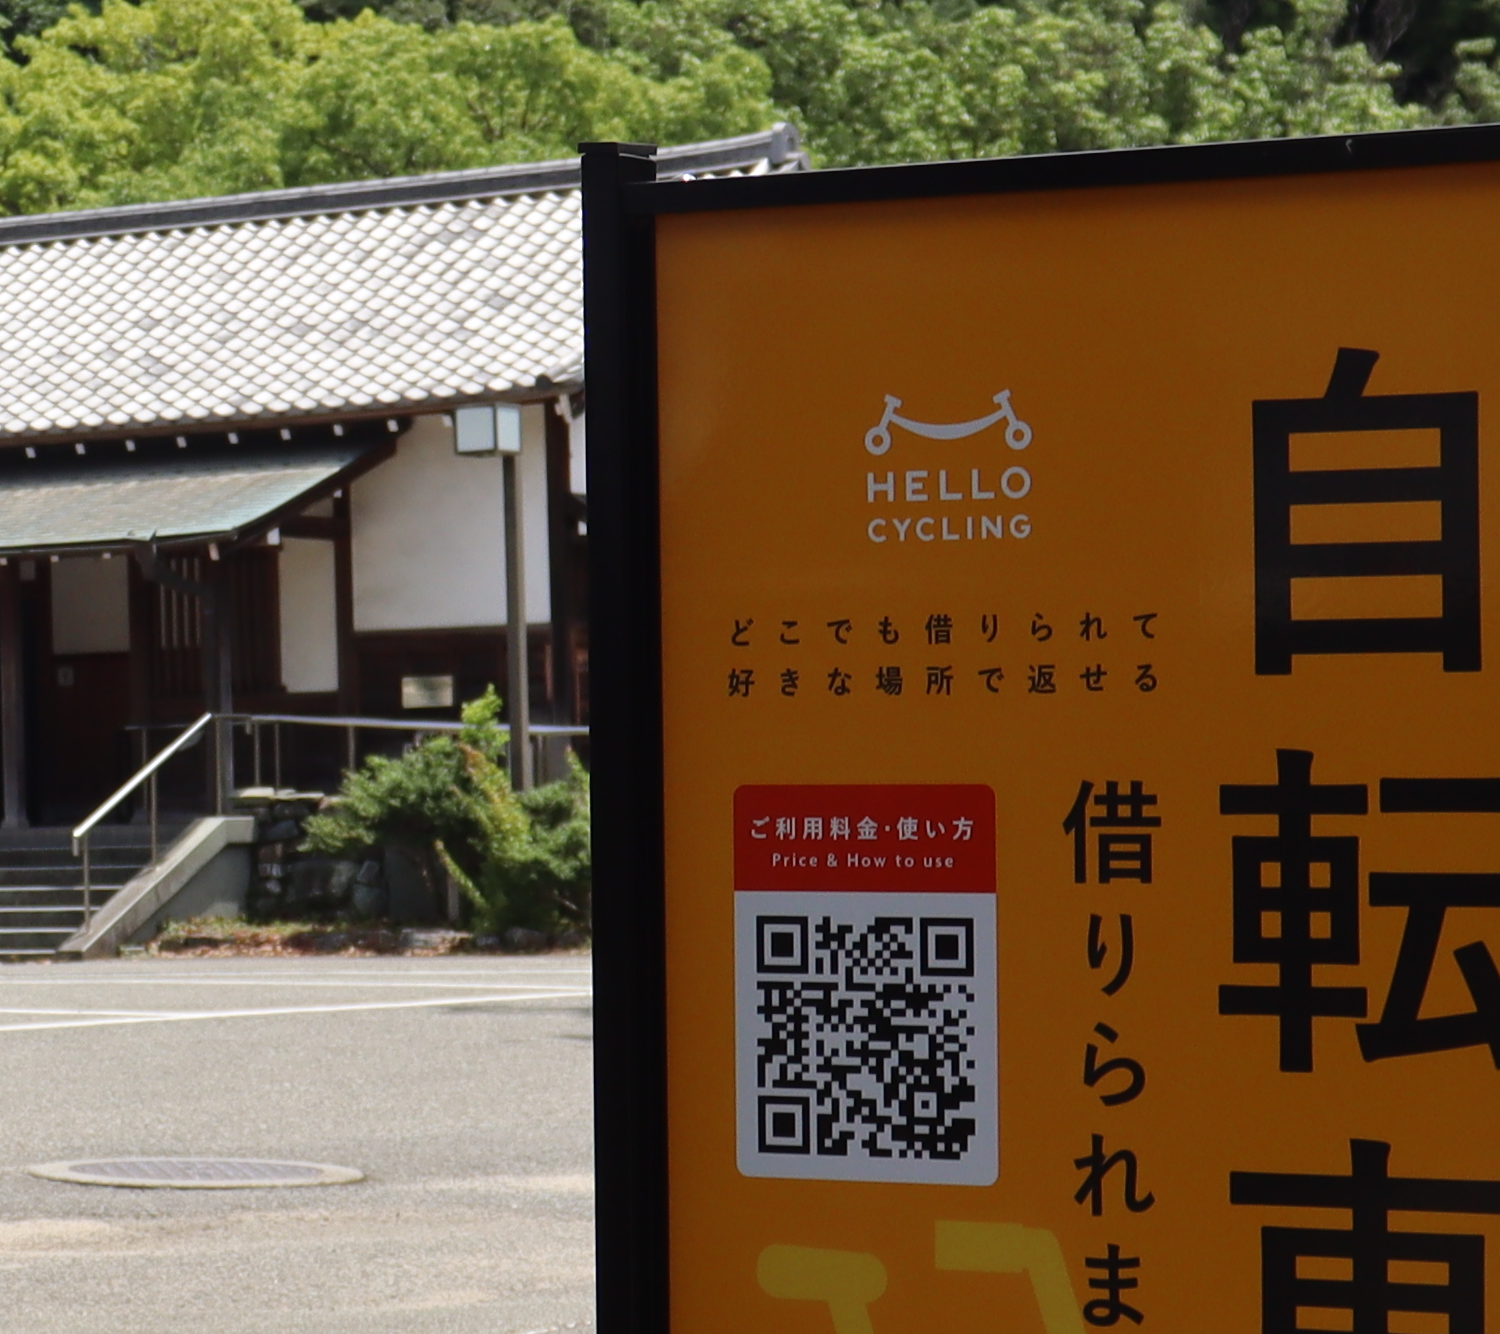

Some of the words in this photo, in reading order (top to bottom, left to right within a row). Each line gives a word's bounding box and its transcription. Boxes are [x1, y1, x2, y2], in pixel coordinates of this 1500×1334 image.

[867, 466, 1031, 503] HELLO
[867, 514, 1032, 543] CYCLING
[729, 612, 1158, 647] どこでも借りられて
[728, 663, 1158, 697] 好きな場所で返せる
[772, 853, 818, 867] Price
[827, 854, 838, 867] &
[847, 854, 887, 867] How
[896, 854, 914, 867] to
[923, 856, 954, 868] use
